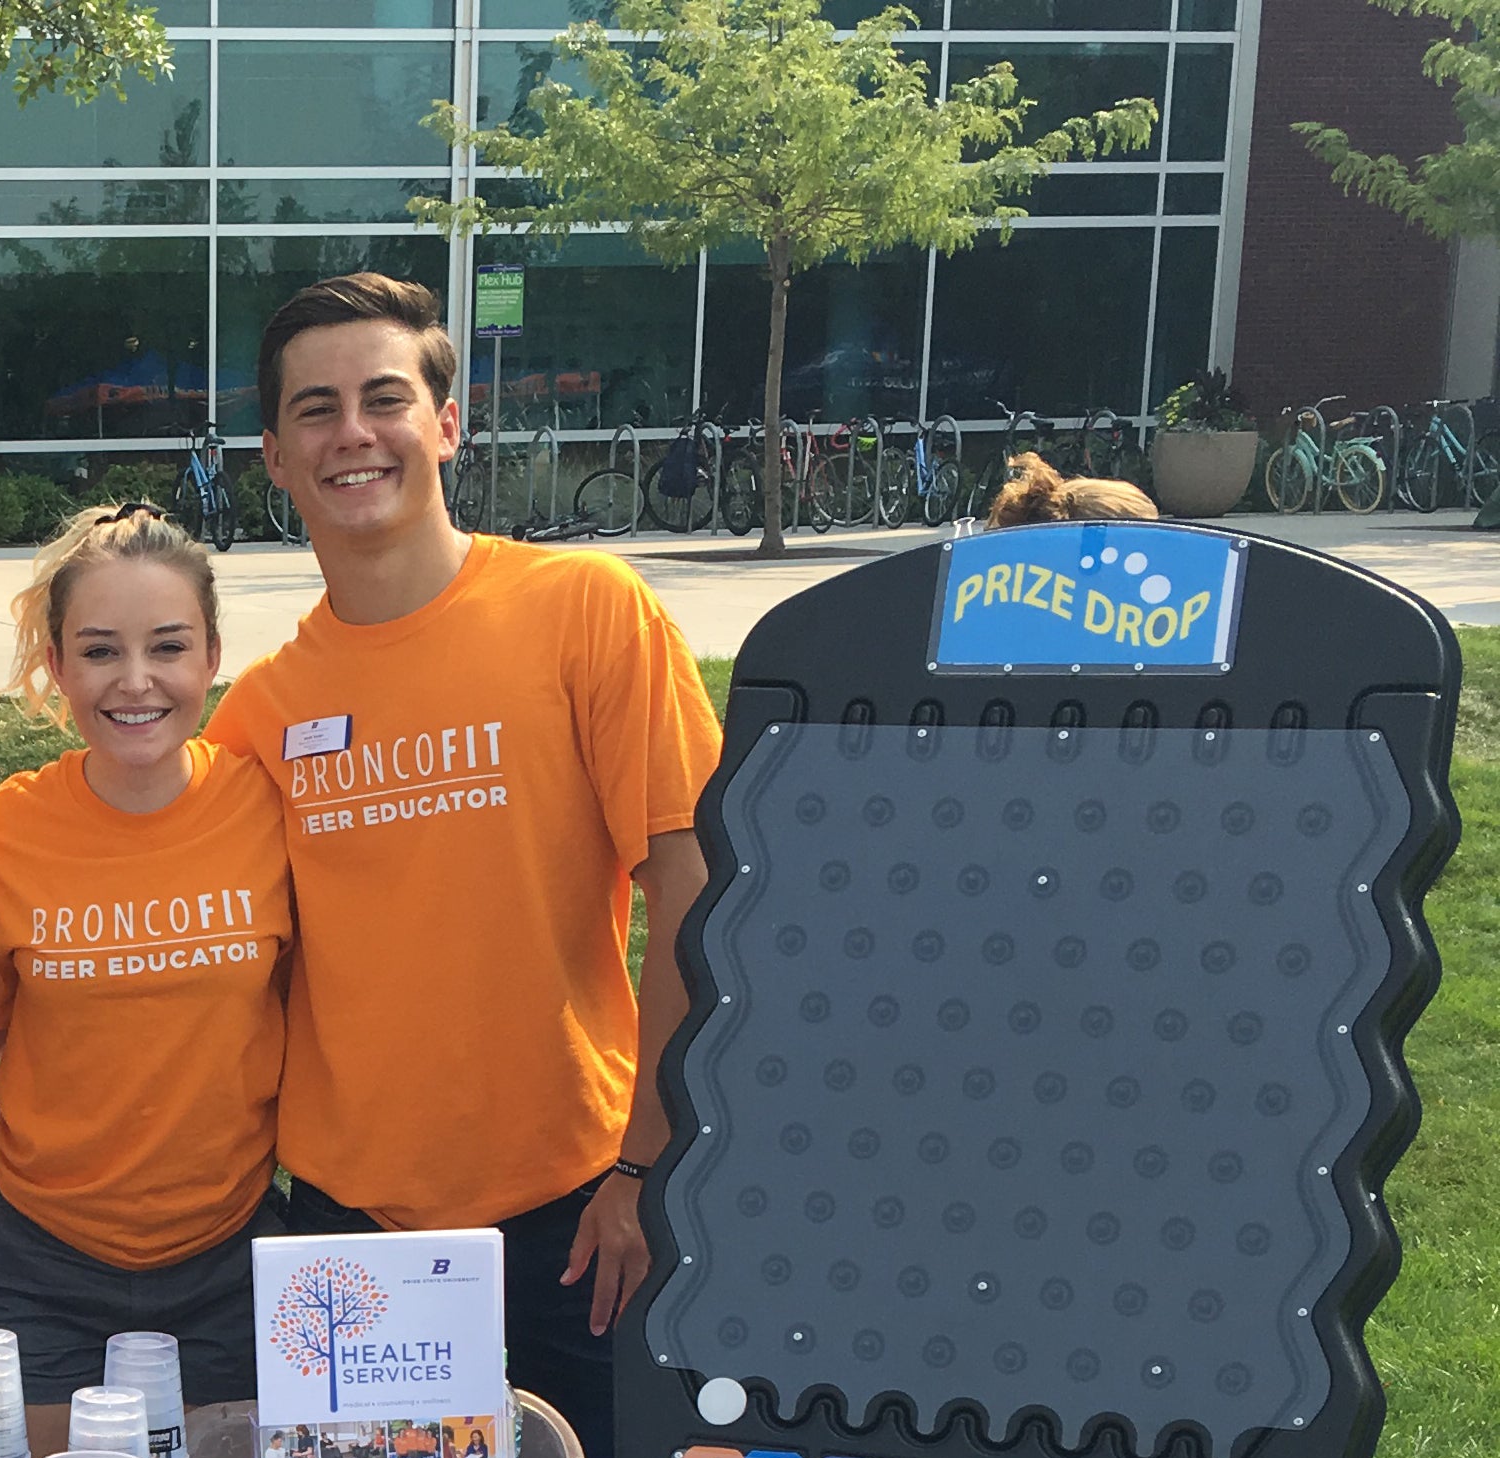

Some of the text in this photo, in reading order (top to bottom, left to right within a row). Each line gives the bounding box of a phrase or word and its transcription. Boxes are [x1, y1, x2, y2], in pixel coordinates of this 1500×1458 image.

[479, 273, 523, 286] Flex Hub
[954, 563, 1211, 647] PRIZE DROP
[291, 721, 503, 799] BRONCOFIT
[363, 786, 508, 827] EDUCATOR
[30, 889, 254, 945] BRONCOFIT
[31, 941, 259, 979] PEER EDUCATOR
[341, 1341, 451, 1365] HEALTH
[342, 1364, 452, 1384] SERVICES
